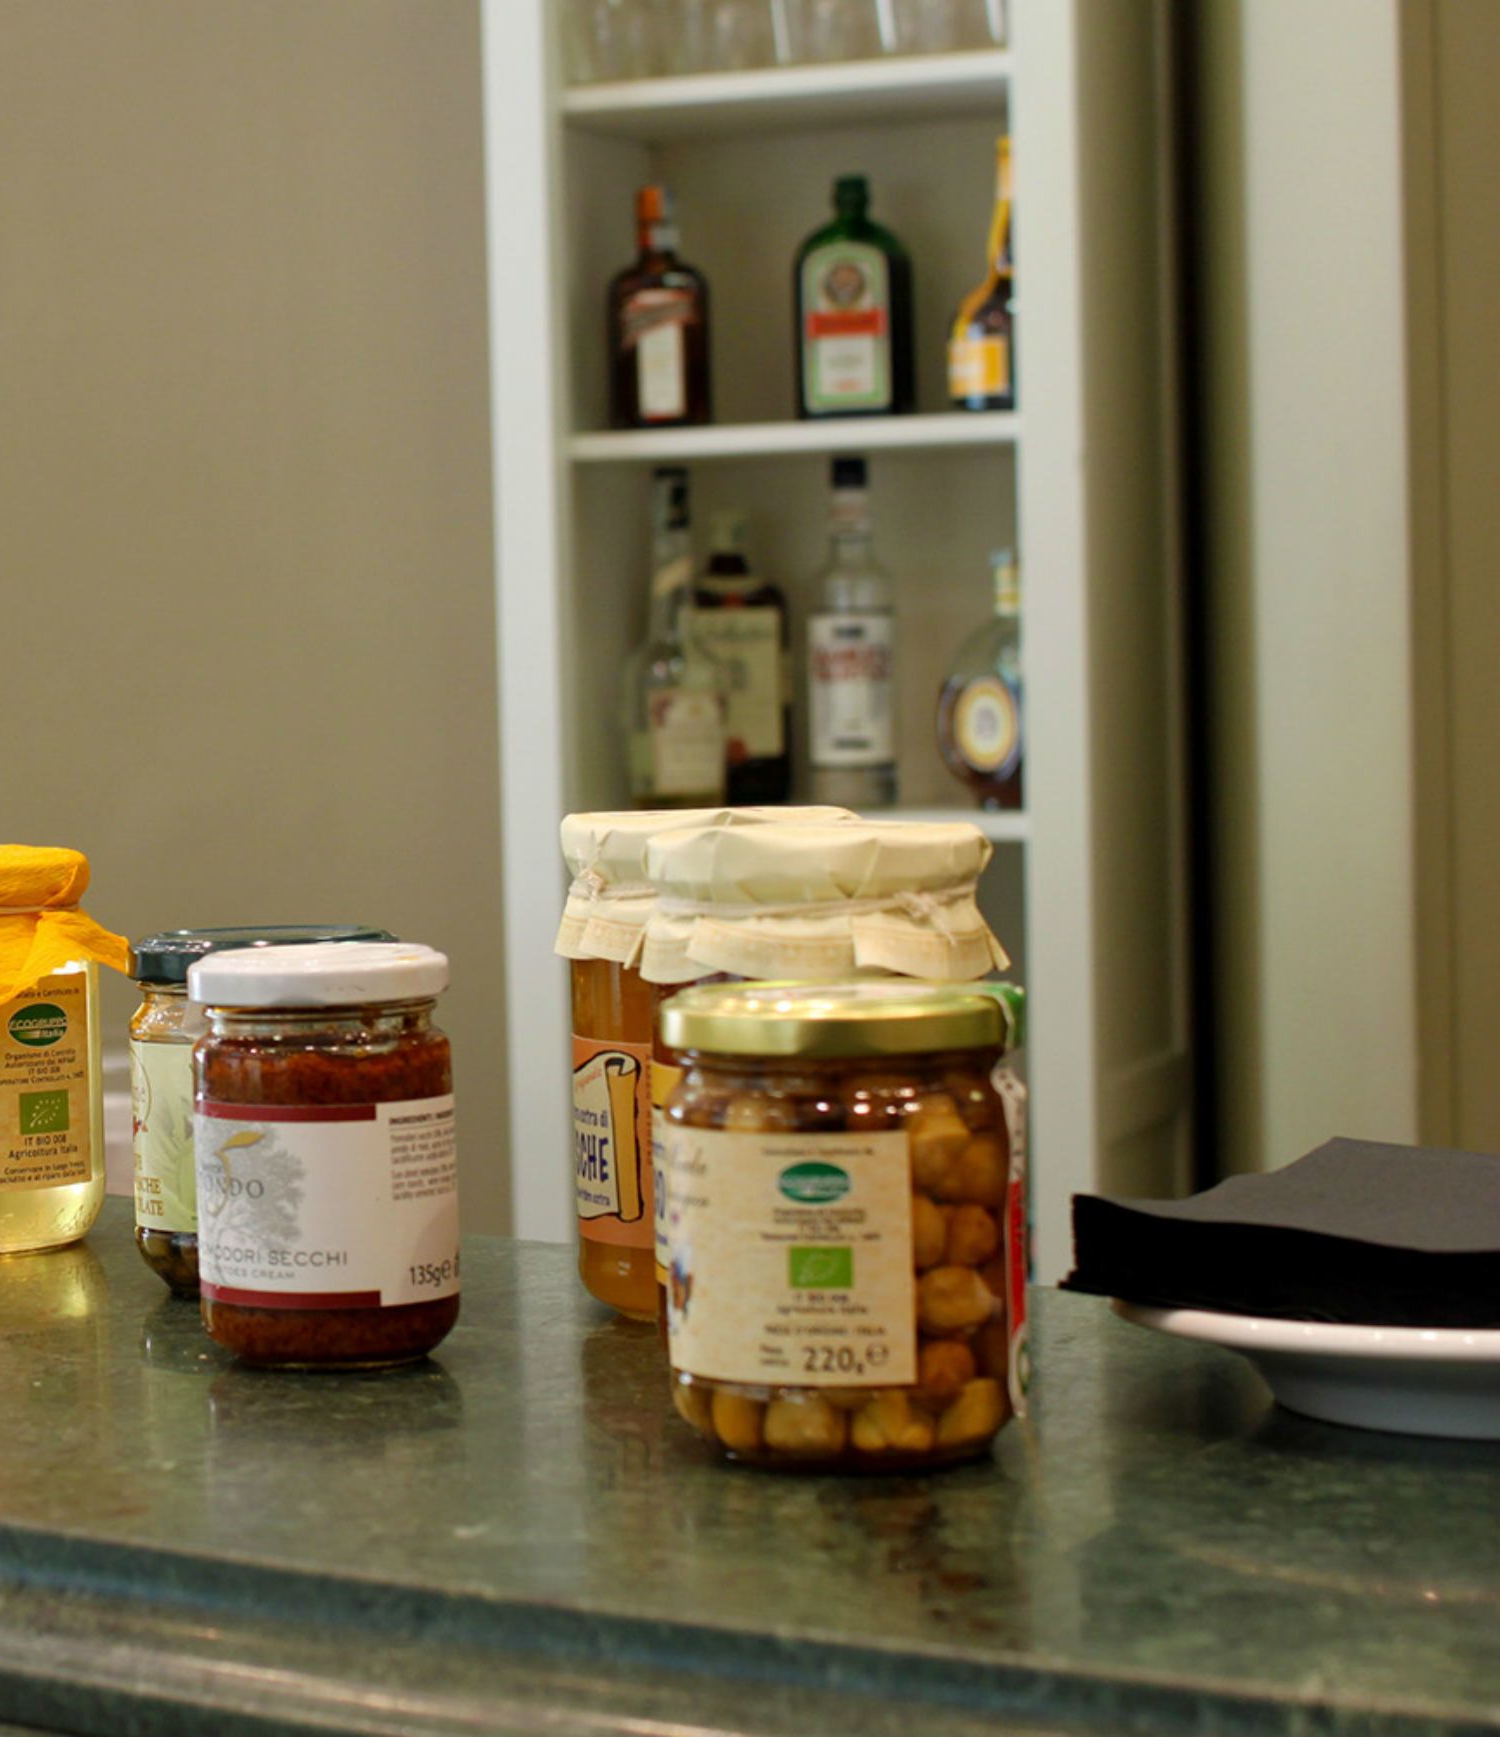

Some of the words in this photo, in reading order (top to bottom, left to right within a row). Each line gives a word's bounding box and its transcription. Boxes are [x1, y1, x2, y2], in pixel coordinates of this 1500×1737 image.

[24, 1136, 33, 1146] IT
[36, 1135, 51, 1146] BIO
[8, 1146, 58, 1161] Agricoltura
[267, 1249, 349, 1268] SECCHI
